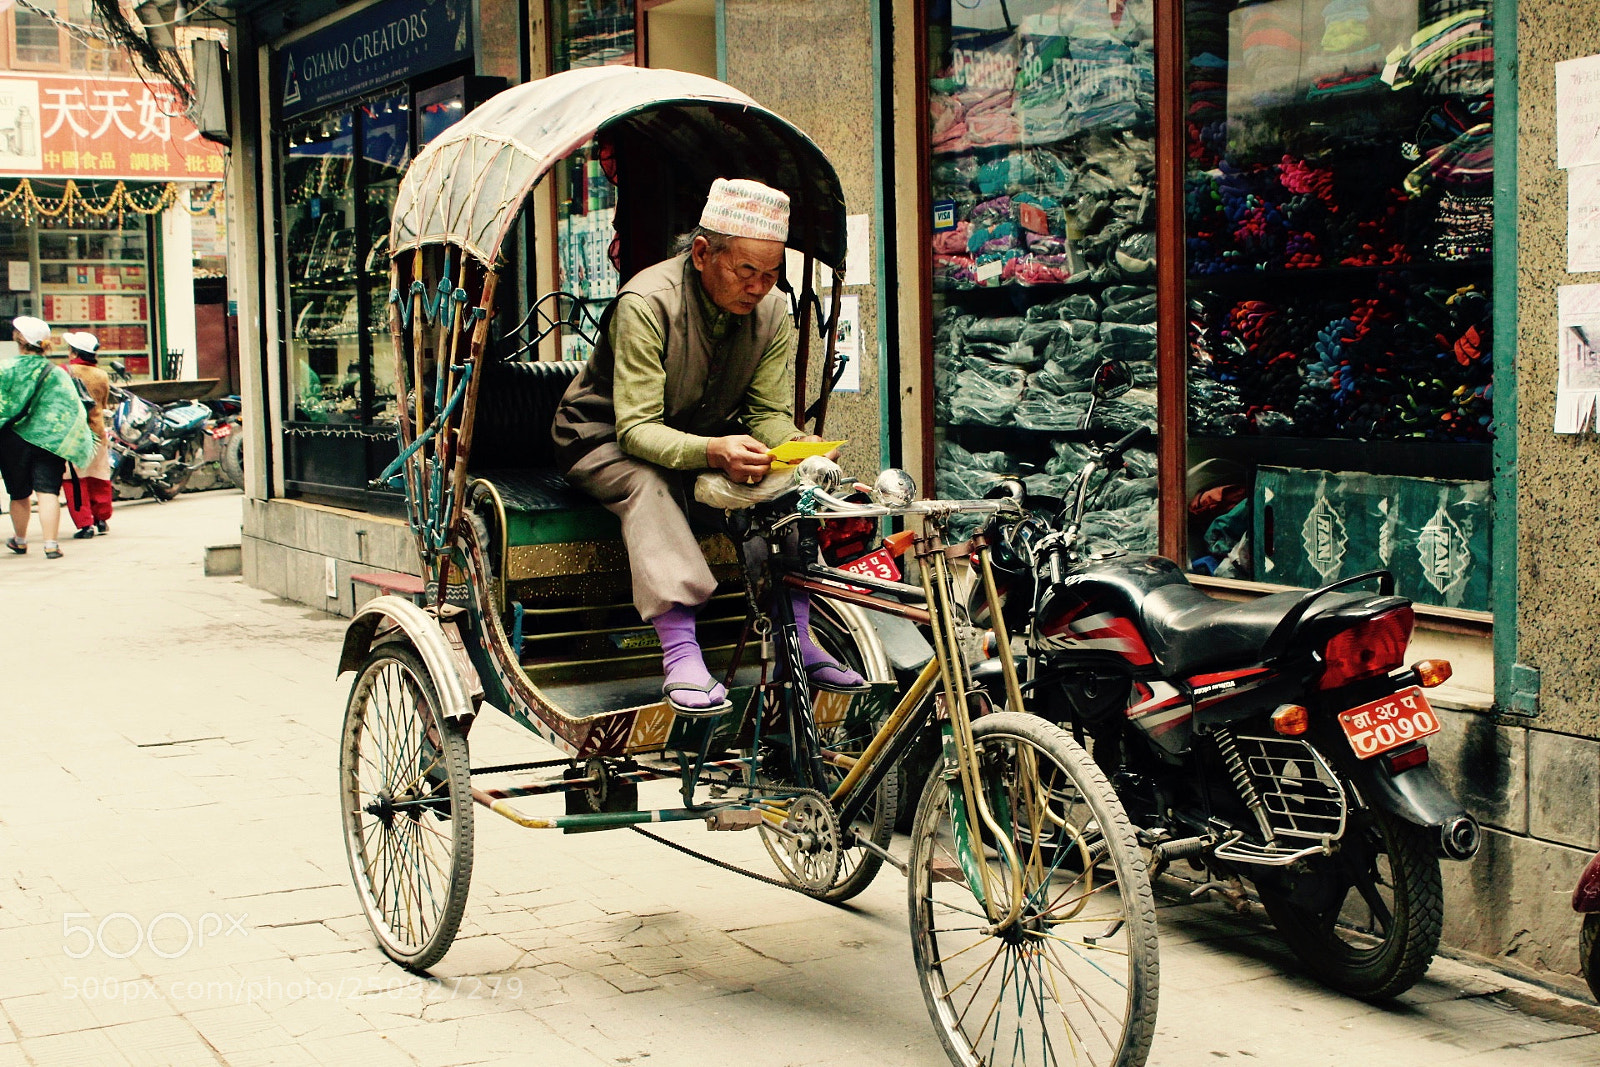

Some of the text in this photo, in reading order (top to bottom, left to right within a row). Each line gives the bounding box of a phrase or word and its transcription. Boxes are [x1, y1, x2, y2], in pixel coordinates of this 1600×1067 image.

[303, 9, 428, 81] GYAMO CREATORS
[44, 151, 116, 170] 中國食品
[937, 211, 951, 221] VISA
[1400, 696, 1417, 709] प
